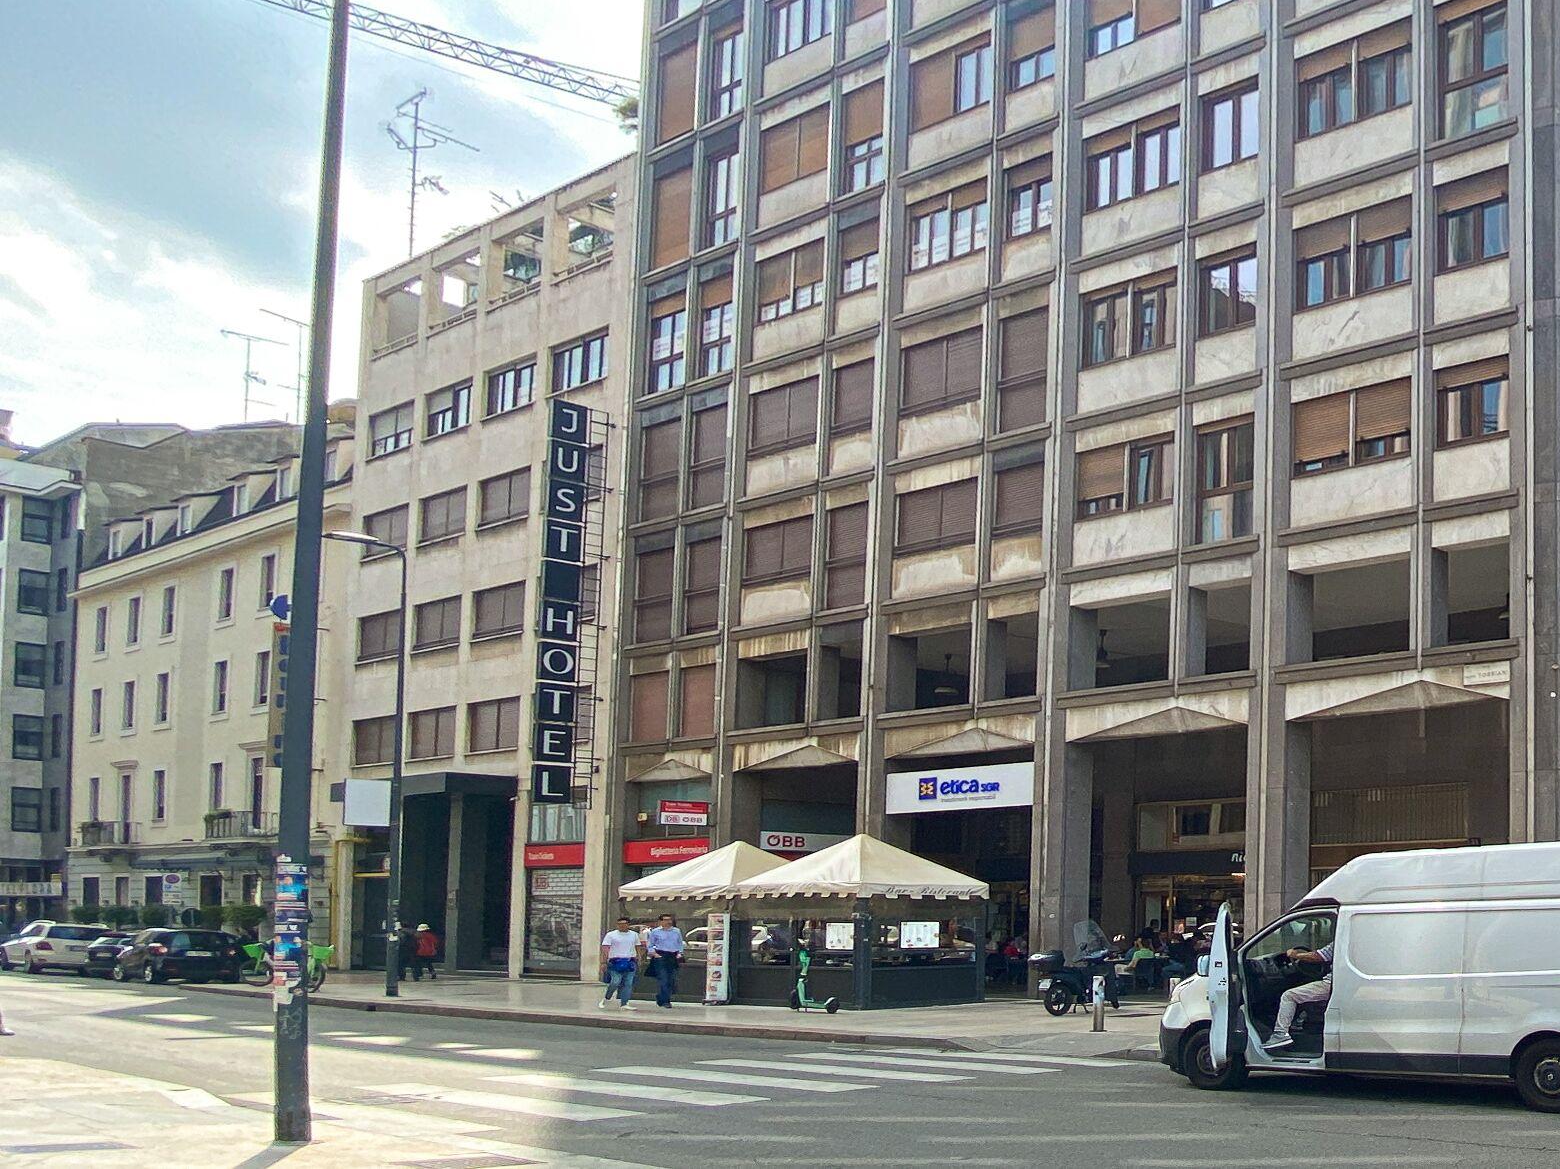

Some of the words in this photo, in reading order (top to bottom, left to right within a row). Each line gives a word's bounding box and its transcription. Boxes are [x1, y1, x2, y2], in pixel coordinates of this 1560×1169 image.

[550, 408, 578, 553] JUST
[541, 607, 574, 797] HOTEL
[940, 779, 979, 795] etica
